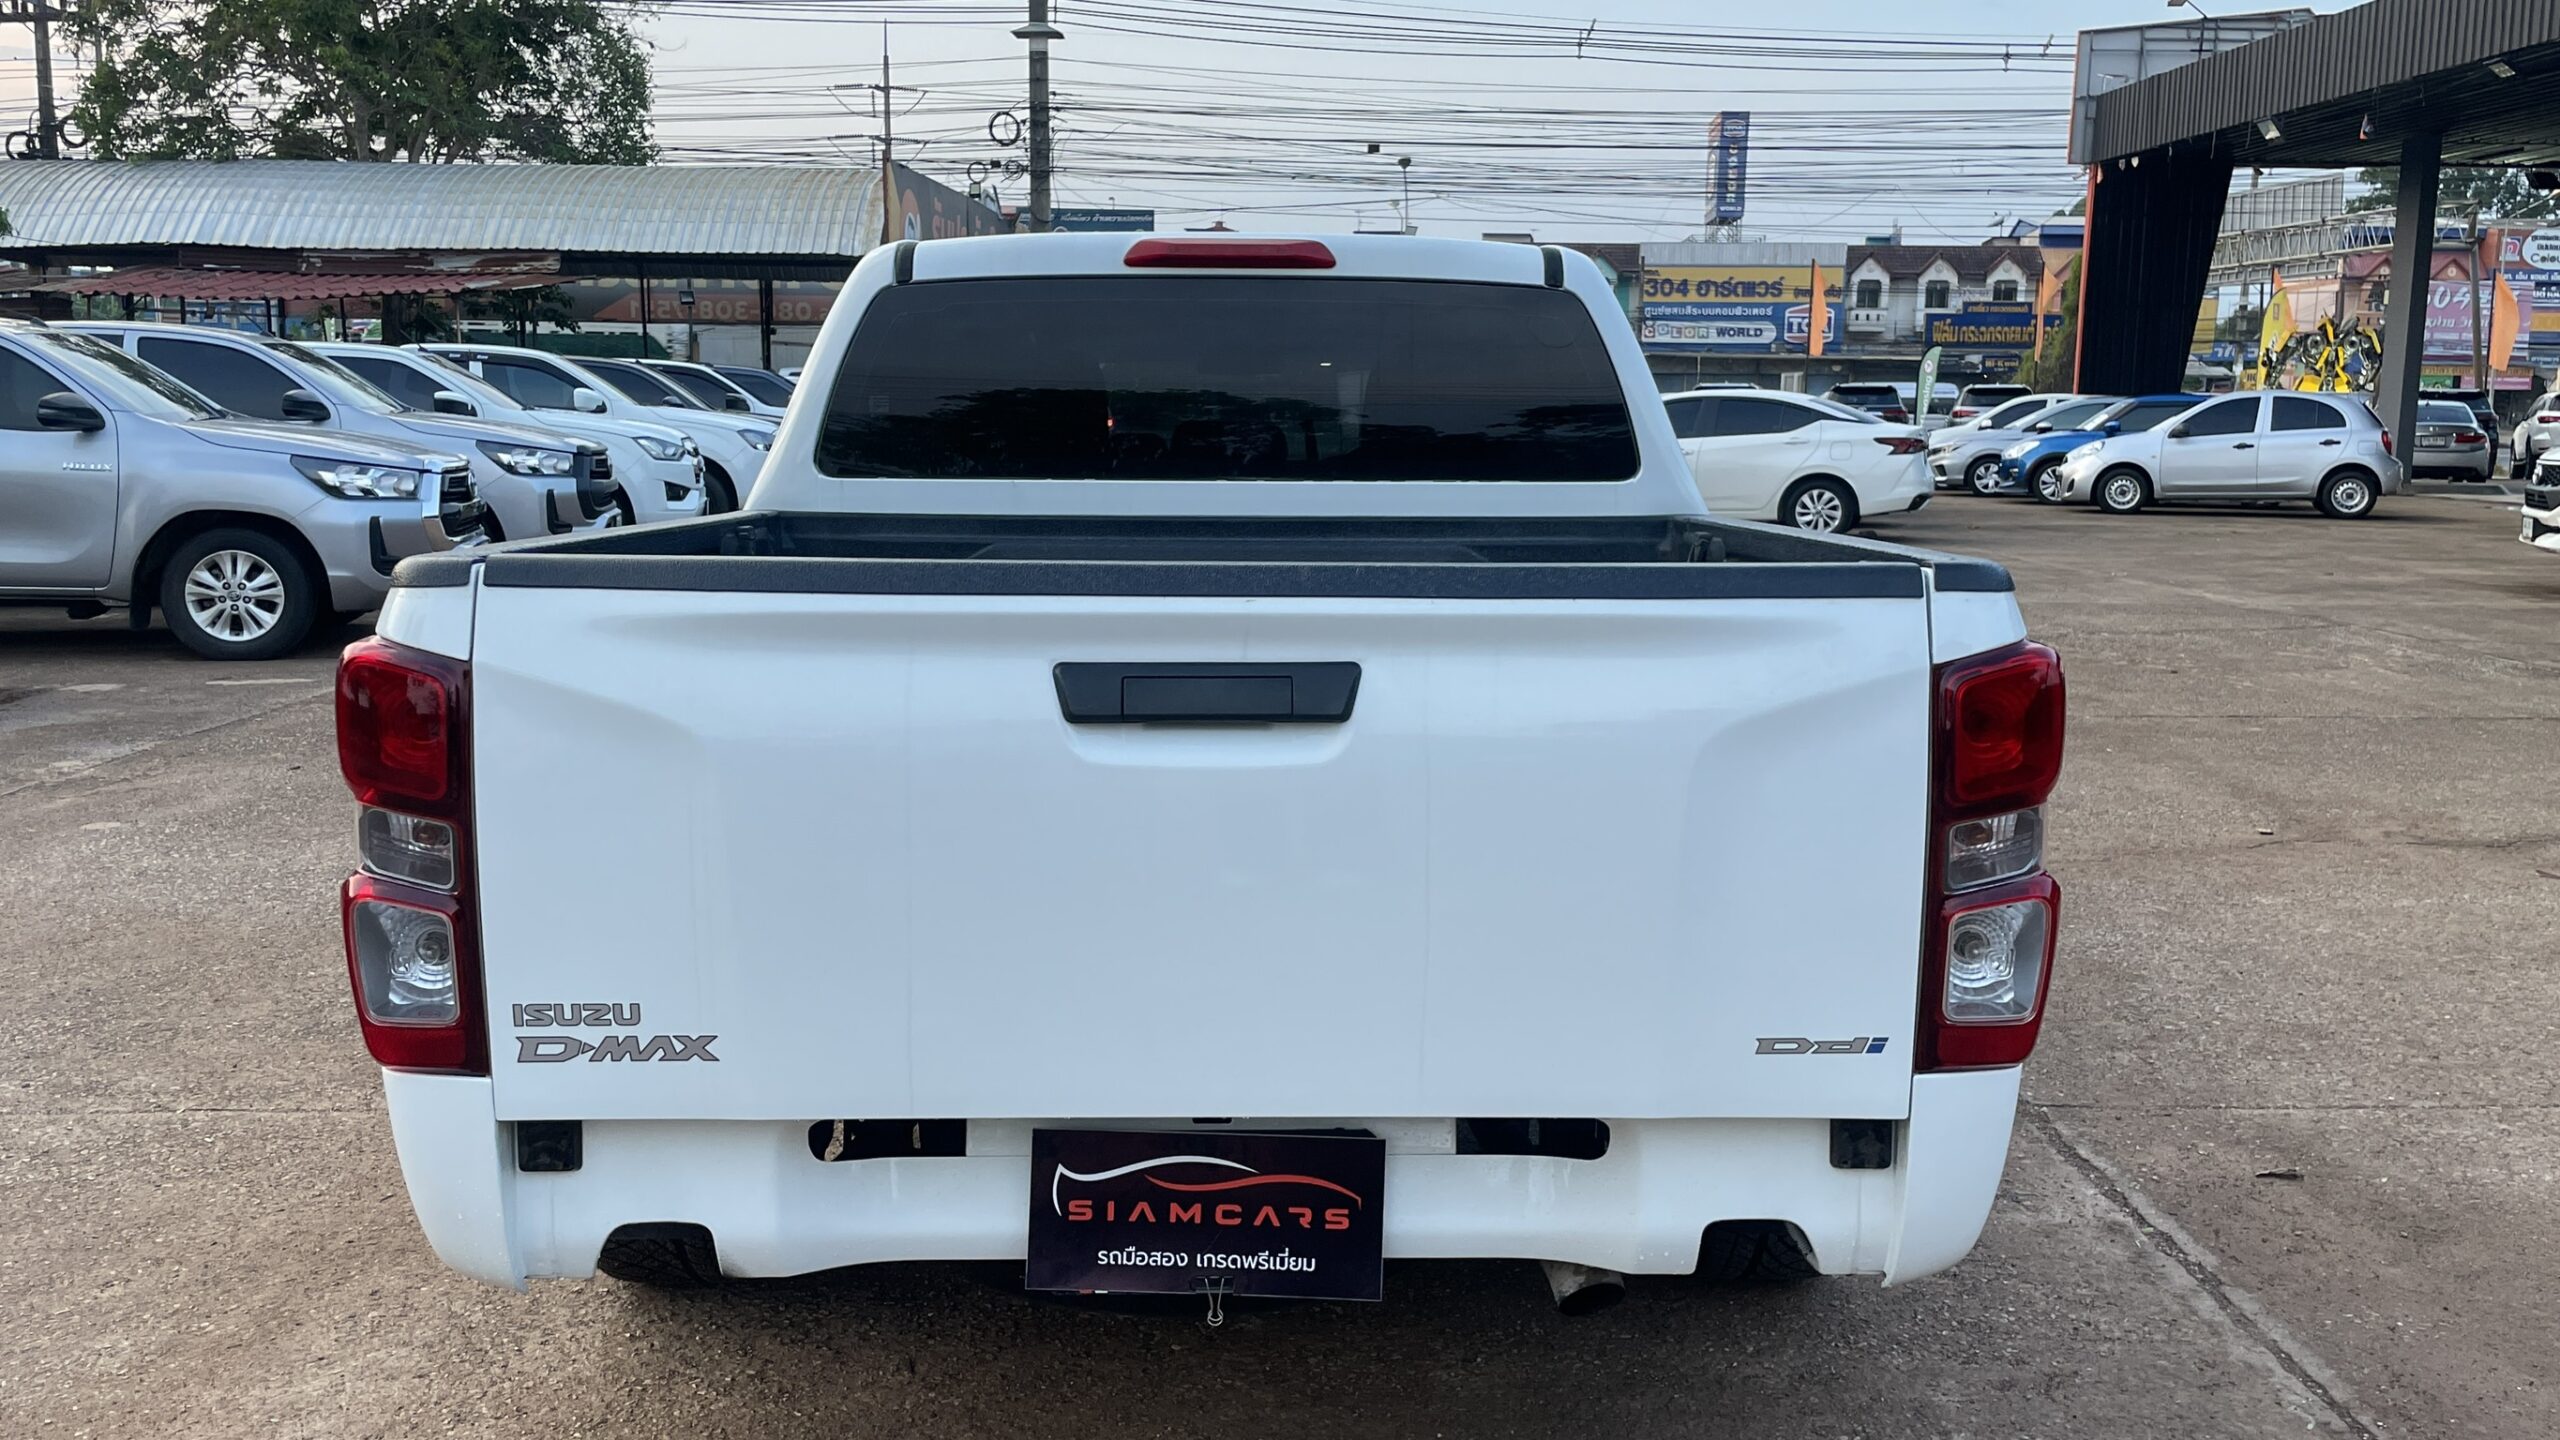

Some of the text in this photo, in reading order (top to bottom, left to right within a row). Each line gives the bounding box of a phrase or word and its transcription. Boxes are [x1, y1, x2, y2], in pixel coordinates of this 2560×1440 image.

[1644, 278, 1690, 298] 304
[1696, 276, 1786, 298] ฮาร์ดแวร์
[1716, 327, 1763, 338] WORLD
[62, 461, 113, 471] HILUX
[512, 1003, 642, 1027] ISUZU
[515, 1035, 720, 1063] D-MAX
[1068, 1200, 1350, 1230] SIAMCARS
[1097, 1246, 1316, 1272] รถมือสอง เกรดพรีเมี่ยม
